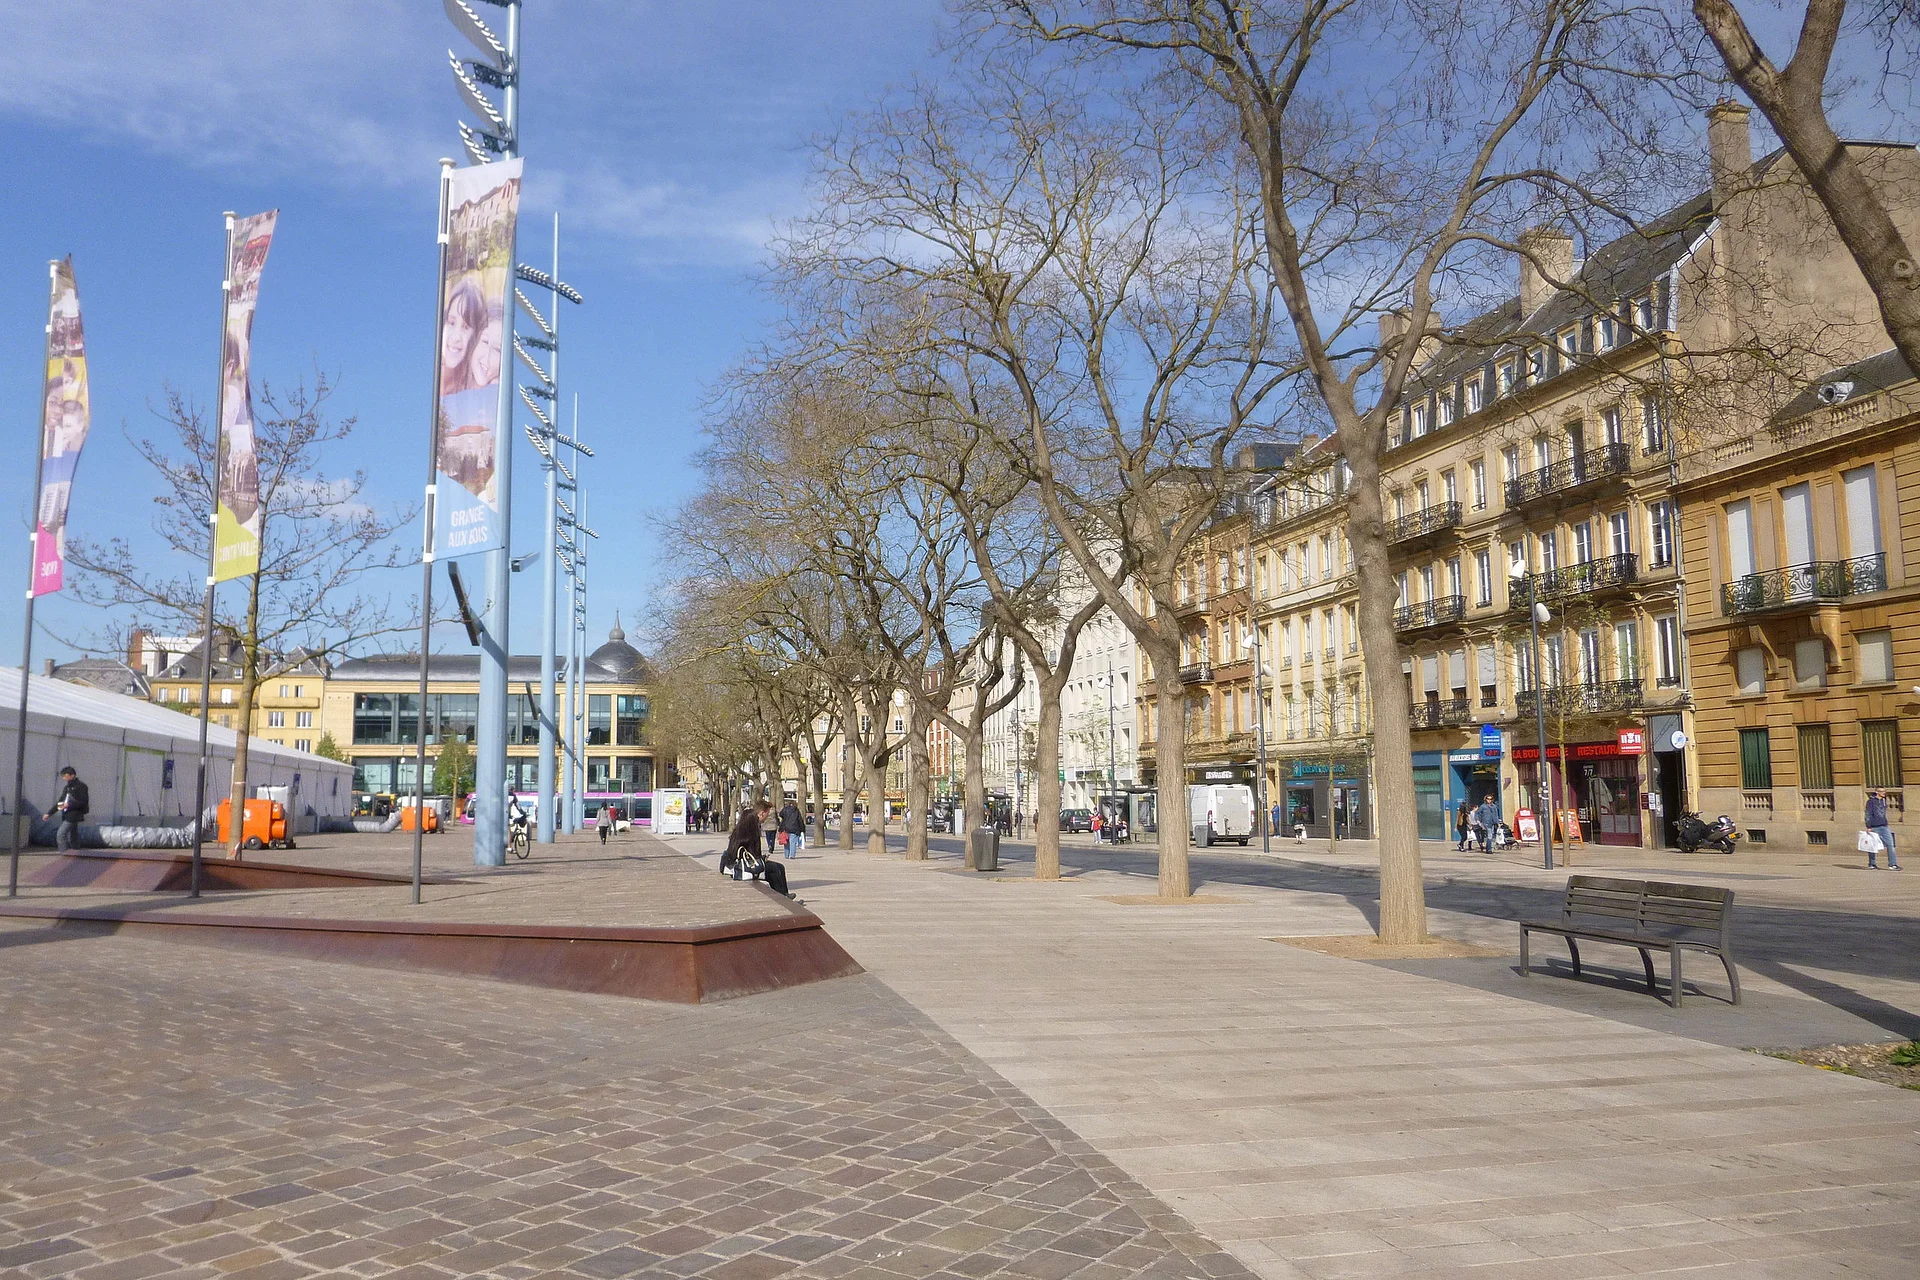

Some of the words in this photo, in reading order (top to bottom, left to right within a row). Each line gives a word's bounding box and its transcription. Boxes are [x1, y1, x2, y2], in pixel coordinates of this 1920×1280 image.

[451, 505, 485, 527] GRANGE
[448, 530, 468, 548] AUX
[1523, 747, 1569, 759] BOUHERE
